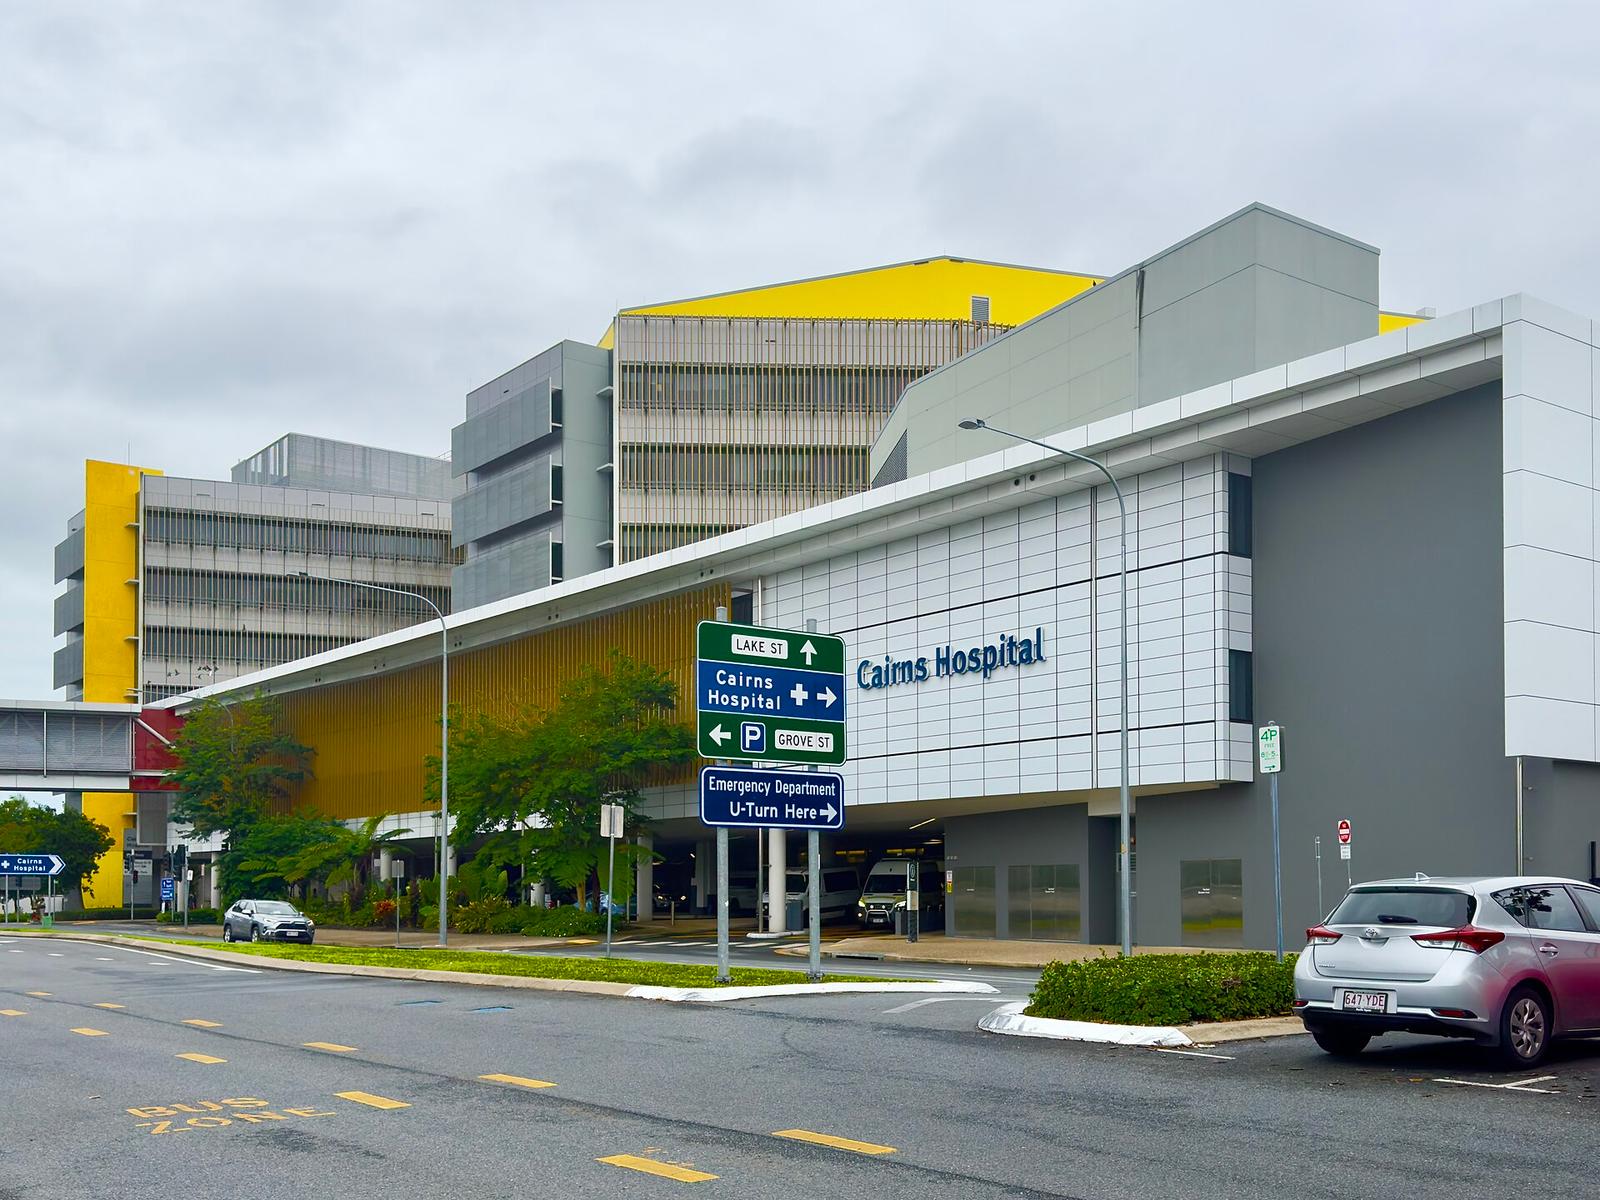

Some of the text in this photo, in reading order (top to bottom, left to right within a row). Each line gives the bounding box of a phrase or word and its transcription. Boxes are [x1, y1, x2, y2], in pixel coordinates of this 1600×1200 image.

[736, 638, 783, 655] LAKE ST
[857, 626, 1047, 690] Cairns Hospital
[716, 669, 773, 689] Cairns
[708, 689, 781, 711] Hospital
[745, 725, 761, 749] P
[778, 733, 830, 748] GROVE ST
[1260, 729, 1278, 741] 4P
[709, 776, 836, 797] Emergency Department
[730, 801, 817, 819] U-Turn Here
[126, 1096, 270, 1118] BUS
[135, 1106, 337, 1135] ZONE
